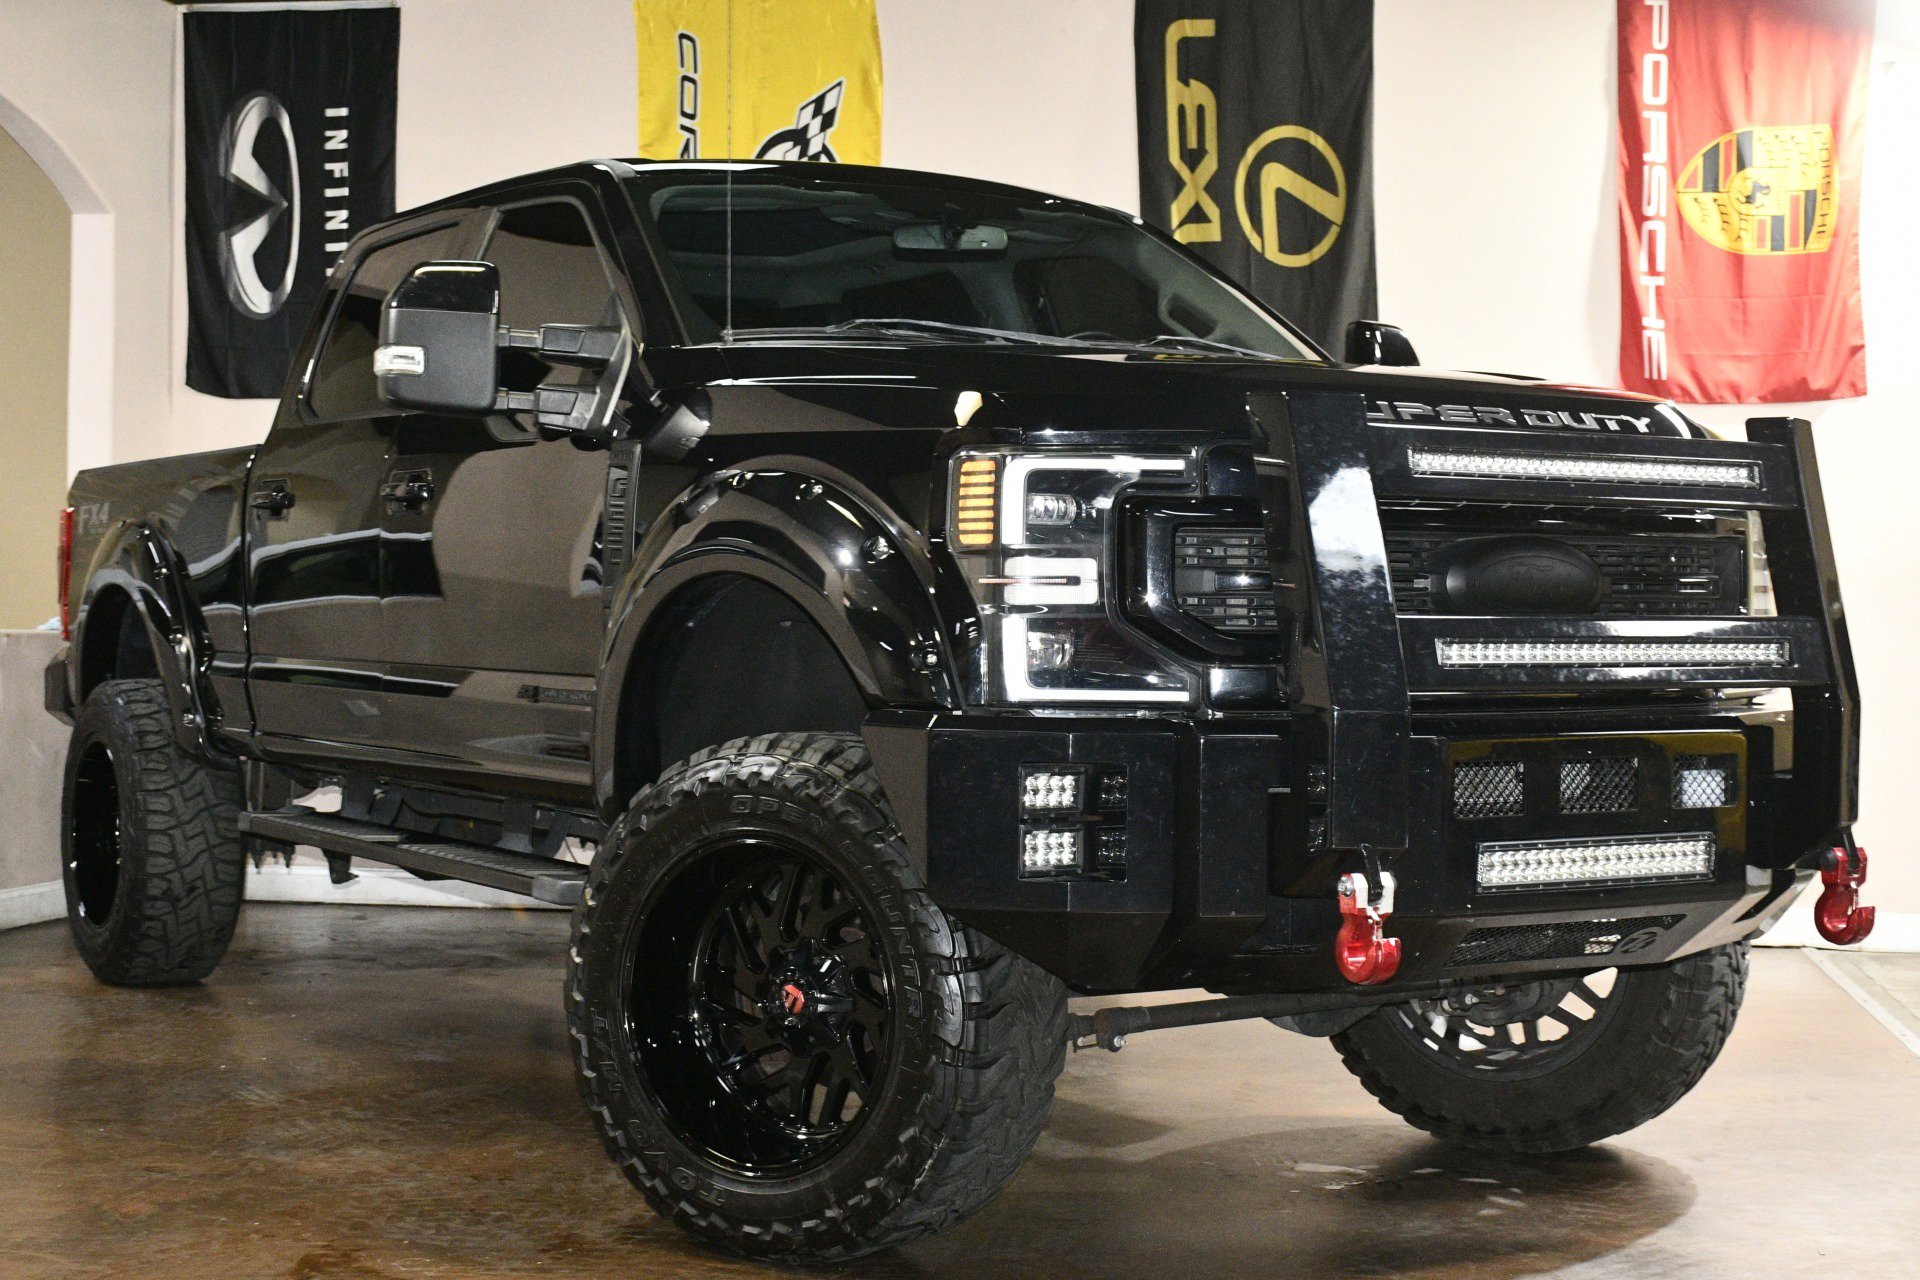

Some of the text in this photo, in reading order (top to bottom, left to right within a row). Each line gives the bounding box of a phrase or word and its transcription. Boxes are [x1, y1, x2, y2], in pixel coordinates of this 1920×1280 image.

[322, 107, 350, 277] INFINI
[1640, 0, 1669, 381] PORSCHE
[1520, 408, 1650, 434] DUTY
[78, 502, 110, 533] FX4
[730, 794, 828, 833] OPEN
